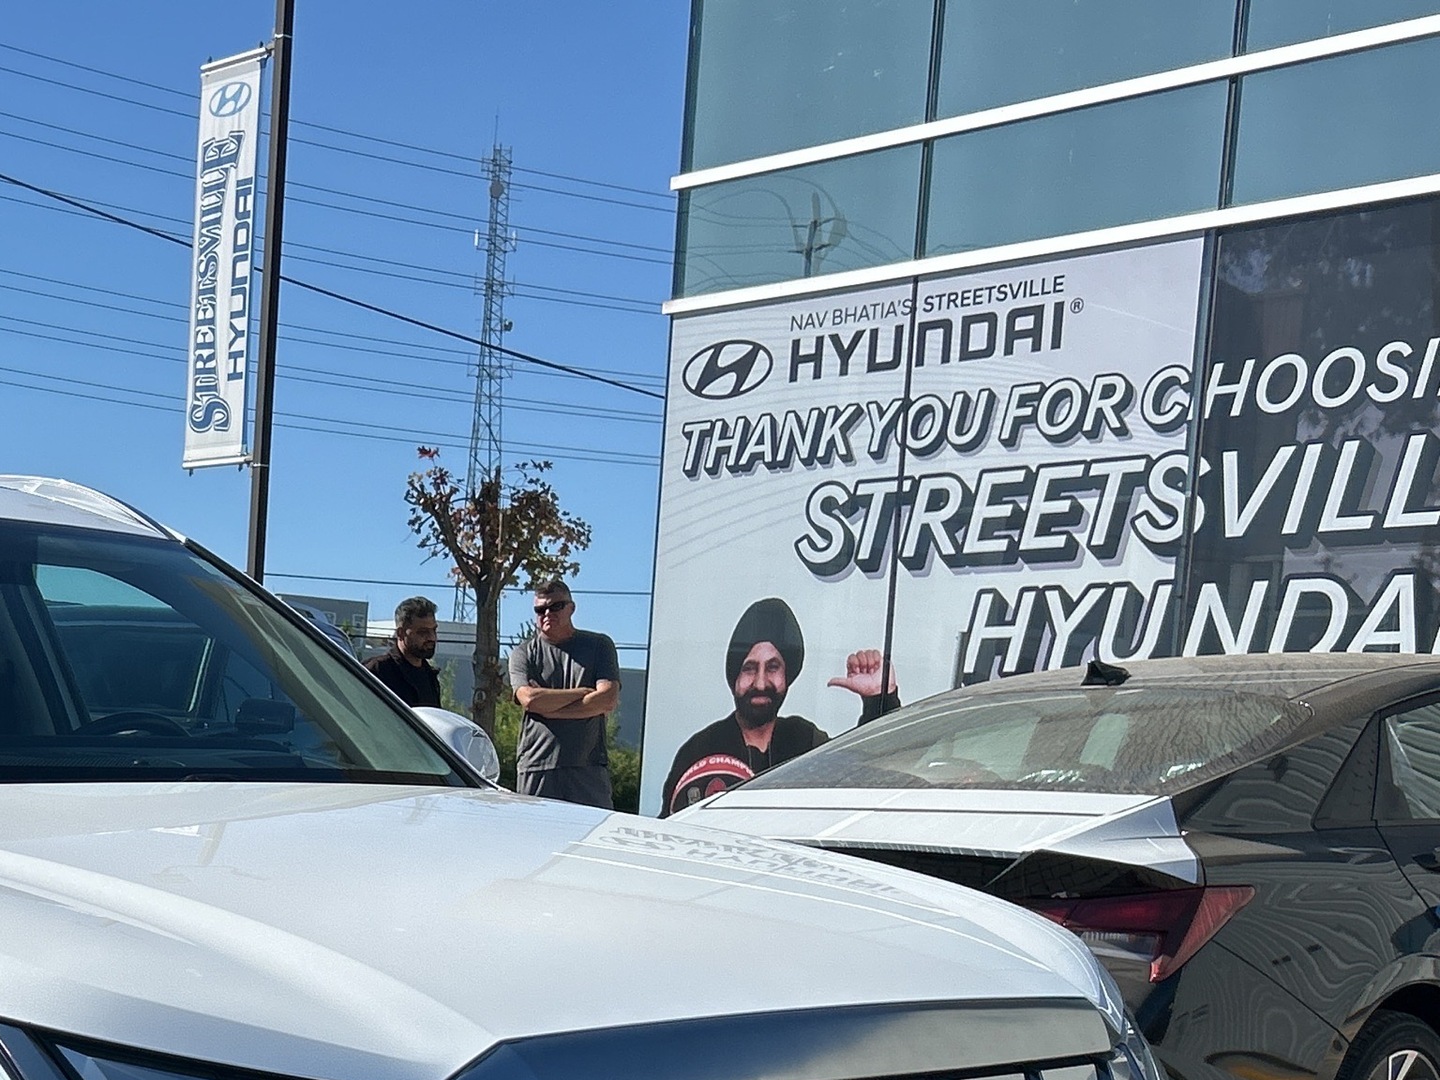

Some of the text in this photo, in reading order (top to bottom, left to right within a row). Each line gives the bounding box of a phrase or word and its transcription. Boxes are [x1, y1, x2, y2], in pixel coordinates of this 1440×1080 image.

[188, 130, 246, 433] STREETSVILLE
[227, 176, 253, 381] HYUNDAI
[789, 275, 1065, 332] NAV BHATIA'S STREETSVILLE
[683, 336, 1440, 476] THANK YOU FOR CHOOSI
[961, 569, 1440, 676] HYUNDA
